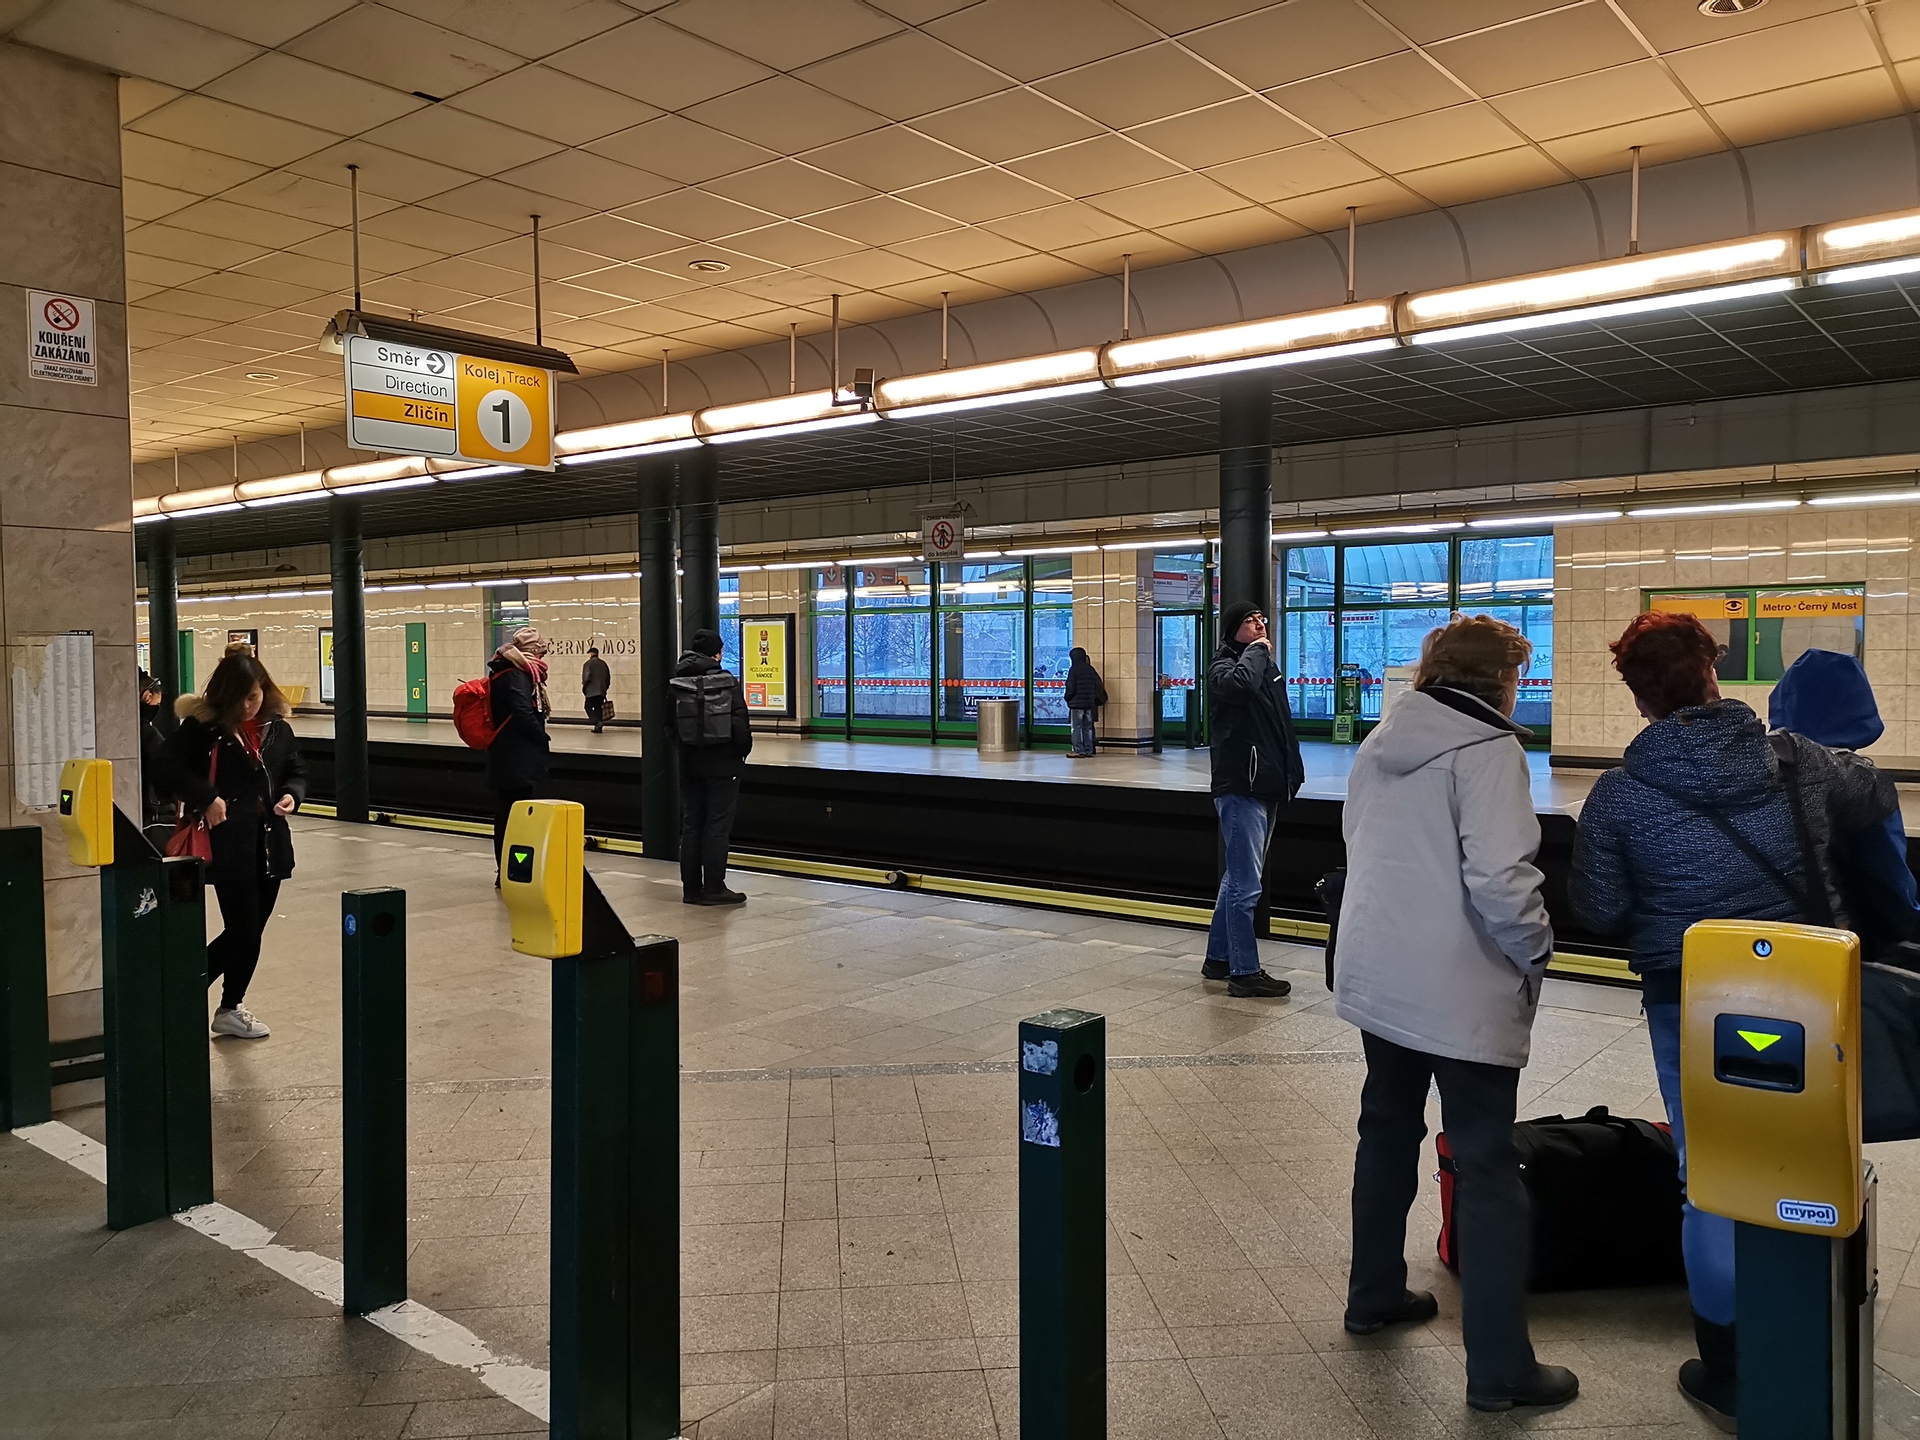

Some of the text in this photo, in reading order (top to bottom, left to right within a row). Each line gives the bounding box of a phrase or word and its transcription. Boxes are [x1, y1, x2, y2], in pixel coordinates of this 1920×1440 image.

[39, 331, 86, 349] KOUŘENÍ
[35, 345, 90, 364] ZAKÁZÁNO
[377, 347, 420, 367] Směr
[464, 363, 541, 388] Kolej Track
[385, 375, 448, 397] Direction
[403, 403, 449, 423] Zličín
[492, 399, 511, 444] 1
[1763, 600, 1858, 612] Metro Černý Most
[547, 637, 639, 655] ČERNÝ MOS
[1785, 1207, 1830, 1219] mypol
